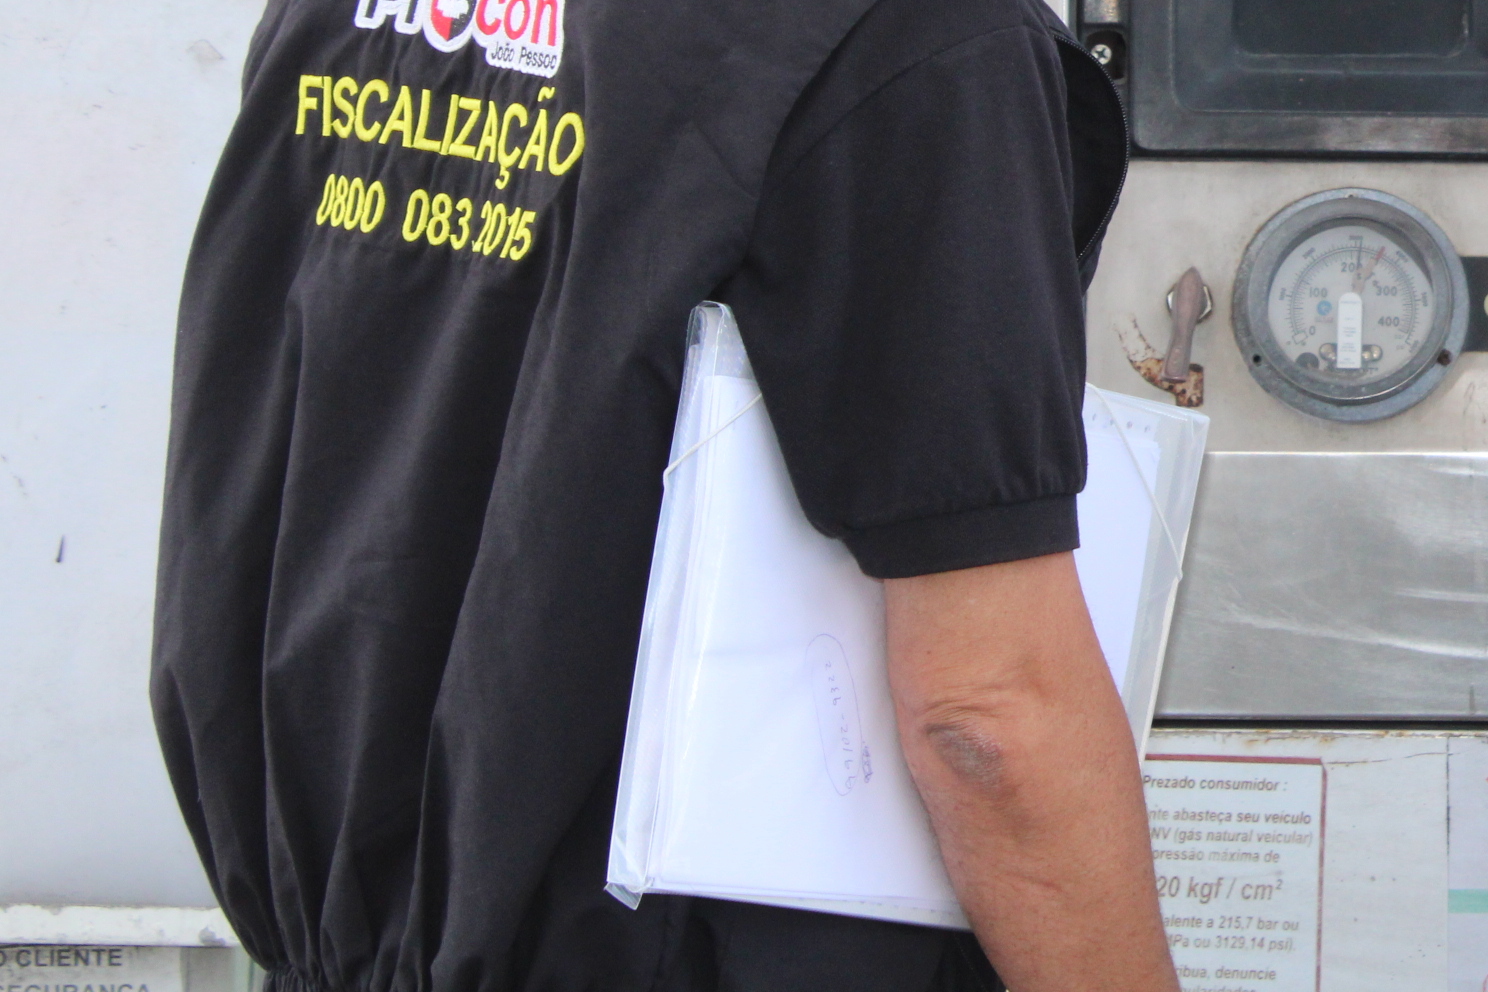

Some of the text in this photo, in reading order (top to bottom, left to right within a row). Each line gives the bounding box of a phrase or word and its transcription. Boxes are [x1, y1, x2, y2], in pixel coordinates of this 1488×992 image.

[519, 46, 557, 69] Pessoa
[295, 74, 586, 190] FISCALIZAÇÃO
[316, 173, 536, 262] 0800 083 2015
[1377, 316, 1400, 327] 400
[1143, 775, 1196, 789] Prezado
[1200, 778, 1280, 792] consumidor
[1149, 809, 1170, 821] nte
[1173, 808, 1233, 825] abasteça
[1236, 813, 1261, 823] seu
[1151, 827, 1172, 840] NV
[1206, 830, 1253, 842] natural
[1208, 850, 1260, 863] máxima
[1264, 850, 1281, 863] de
[1157, 876, 1180, 898] 20
[1187, 876, 1224, 904] kgf
[1164, 914, 1202, 928] alente
[1257, 917, 1278, 931] bar
[1282, 920, 1300, 932] ou
[16, 948, 122, 967] CLIENTE
[1215, 965, 1278, 981] denuncie
